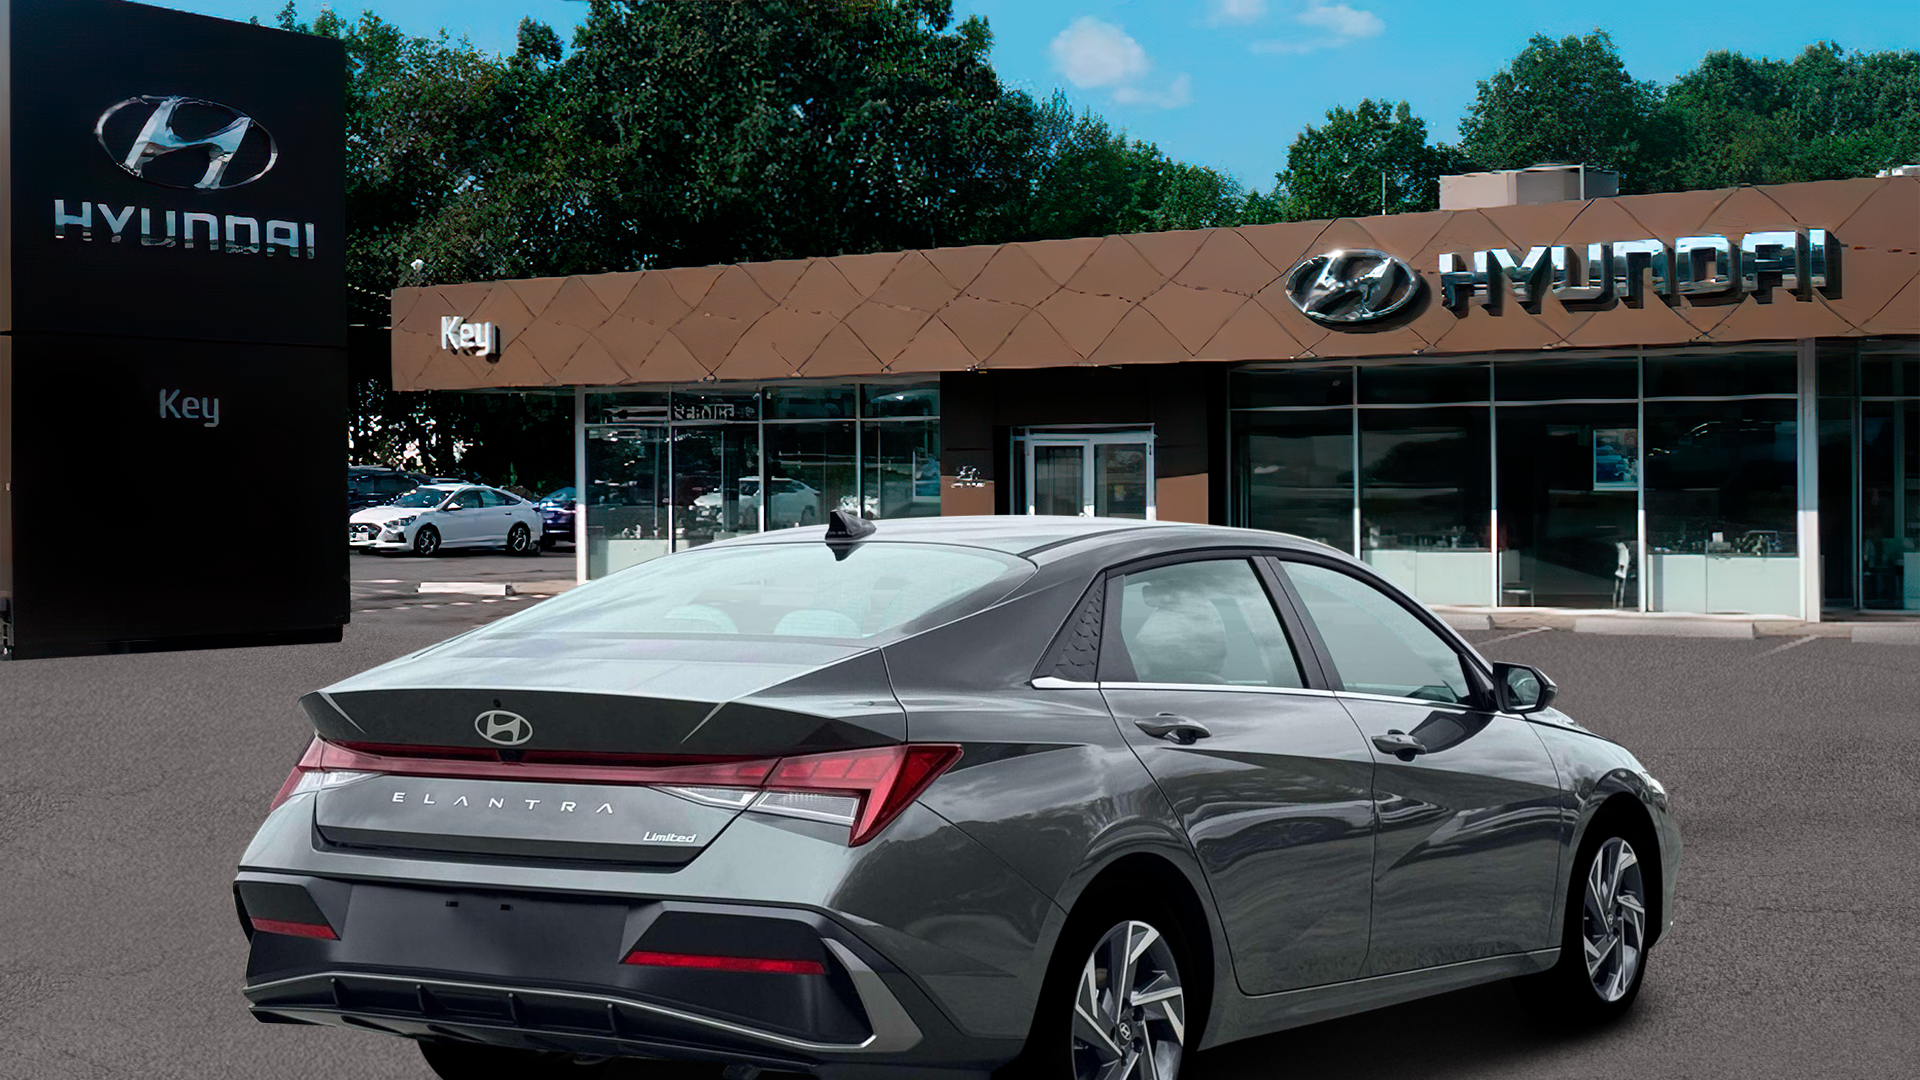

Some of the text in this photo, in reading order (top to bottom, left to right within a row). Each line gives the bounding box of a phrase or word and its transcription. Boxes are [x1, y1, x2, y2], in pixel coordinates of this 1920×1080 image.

[54, 199, 315, 260] HYUNDAI
[1438, 228, 1839, 315] HYUNDAI
[441, 315, 494, 358] Key
[159, 389, 220, 428] Key
[391, 791, 614, 815] ELANTRA
[642, 830, 698, 844] Limited
